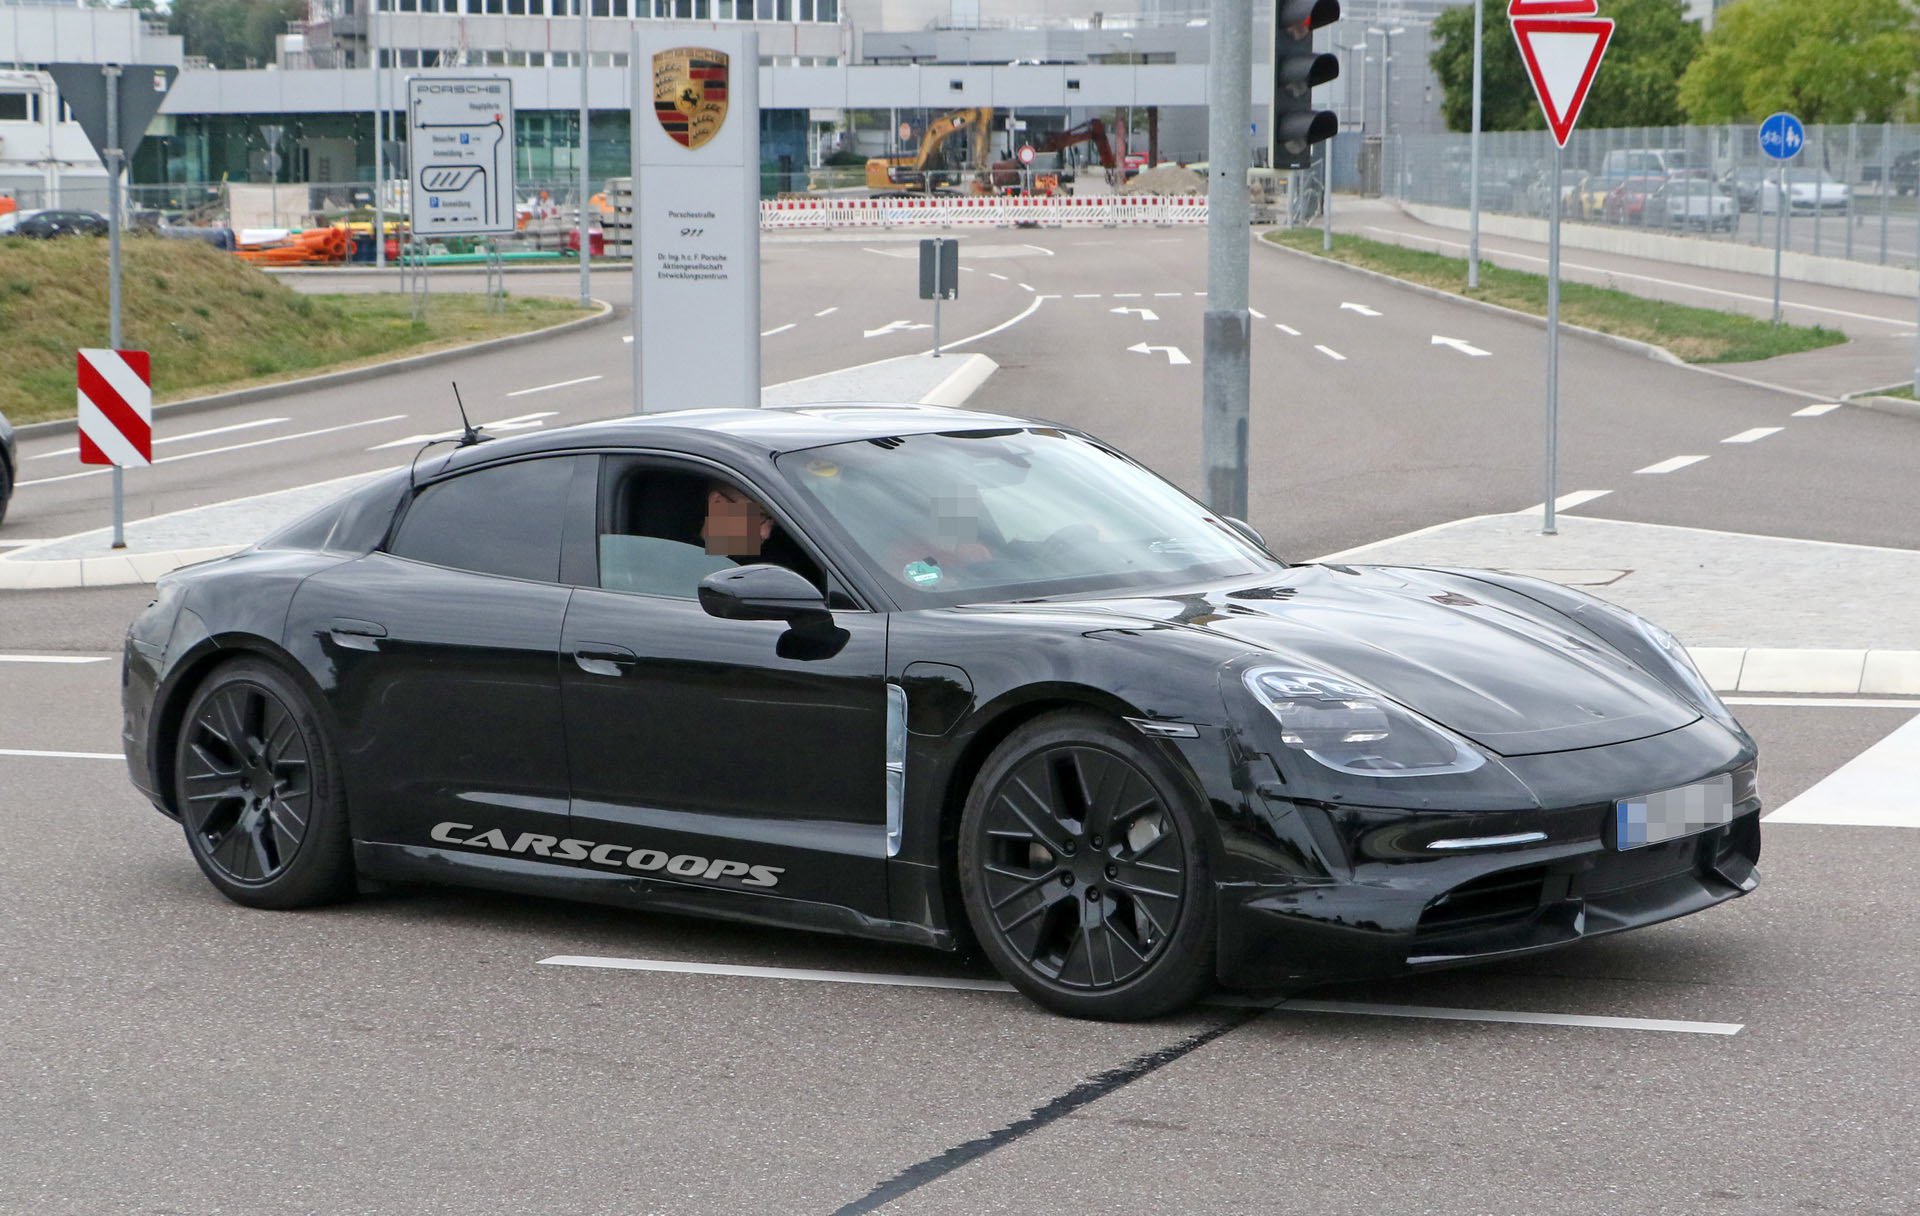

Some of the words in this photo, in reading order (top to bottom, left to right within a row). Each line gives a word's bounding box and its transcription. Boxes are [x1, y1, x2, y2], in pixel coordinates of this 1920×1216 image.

[417, 85, 501, 93] PORSCHE
[701, 253, 727, 261] Porsche
[663, 263, 723, 271] Aktiengesellschaft
[658, 272, 728, 280] Entwicklungszentrum
